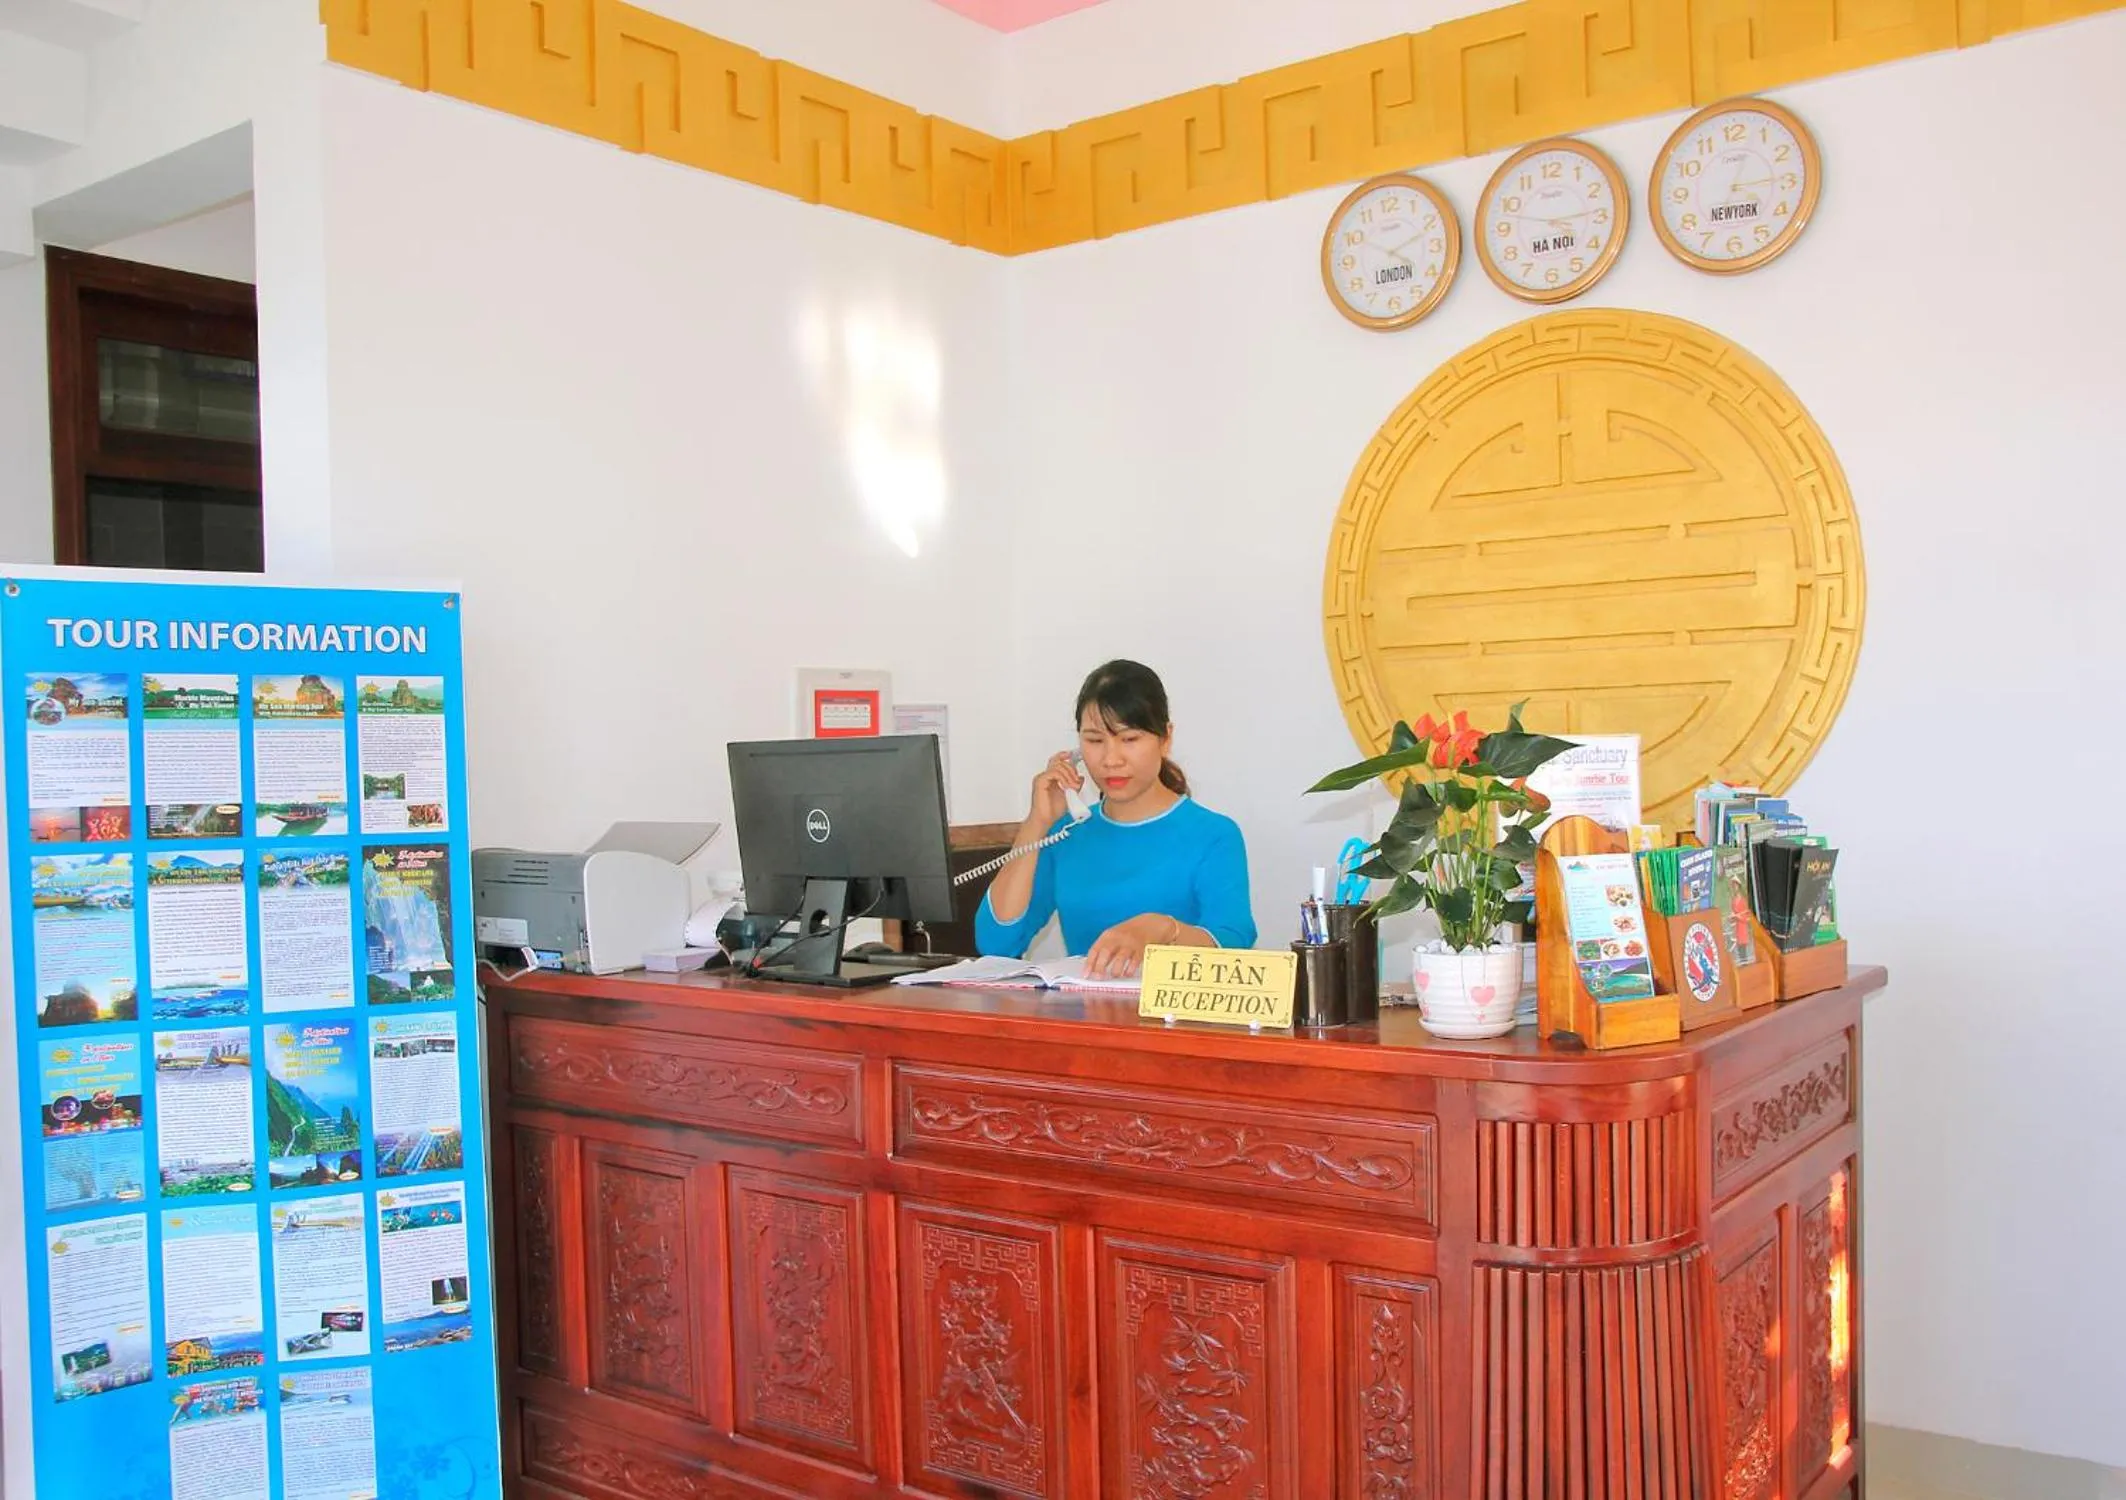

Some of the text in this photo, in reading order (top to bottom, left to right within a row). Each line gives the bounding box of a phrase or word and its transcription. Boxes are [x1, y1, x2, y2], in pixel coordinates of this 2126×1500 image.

[1723, 124, 1746, 142] 12
[1760, 127, 1767, 144] 1
[1698, 137, 1713, 156] 11
[1774, 144, 1790, 162] 2
[1542, 162, 1562, 179] 12
[1574, 166, 1581, 182] 1
[1676, 160, 1701, 178] 10
[1519, 175, 1531, 191] 11
[1781, 173, 1796, 190] 3
[1587, 182, 1601, 199] 2
[1673, 188, 1689, 204] 9
[1380, 197, 1400, 213] 12
[1409, 200, 1417, 215] 1
[1502, 197, 1521, 213] 10
[1711, 203, 1757, 222] NEWYORK
[1773, 201, 1787, 217] 4
[1360, 209, 1373, 224] 11
[1423, 214, 1436, 230] 2
[1593, 208, 1608, 225] 3
[1681, 213, 1696, 231] 8
[1496, 222, 1511, 238] 9
[1754, 225, 1769, 243] 5
[1344, 230, 1363, 247] 10
[1430, 238, 1441, 254] 3
[1586, 236, 1600, 249] 4
[1700, 232, 1715, 249] 7
[1726, 236, 1743, 253] 6
[1504, 246, 1517, 261] 8
[1342, 255, 1355, 271] 9
[1425, 263, 1437, 277] 4
[1521, 263, 1534, 278] 7
[1570, 257, 1583, 273] 5
[1375, 265, 1413, 285] LONDON
[1545, 268, 1558, 283] 6
[1350, 277, 1363, 292] 8
[1410, 285, 1423, 299] 5
[1366, 292, 1379, 304] 7
[1388, 296, 1401, 310] 6
[47, 618, 427, 654] TOUR INFORMATION
[1563, 746, 1627, 768] Sanctuary
[810, 821, 827, 830] DELL
[1169, 953, 1267, 986] LỄ TÂN
[1153, 989, 1279, 1016] RECEPTION
